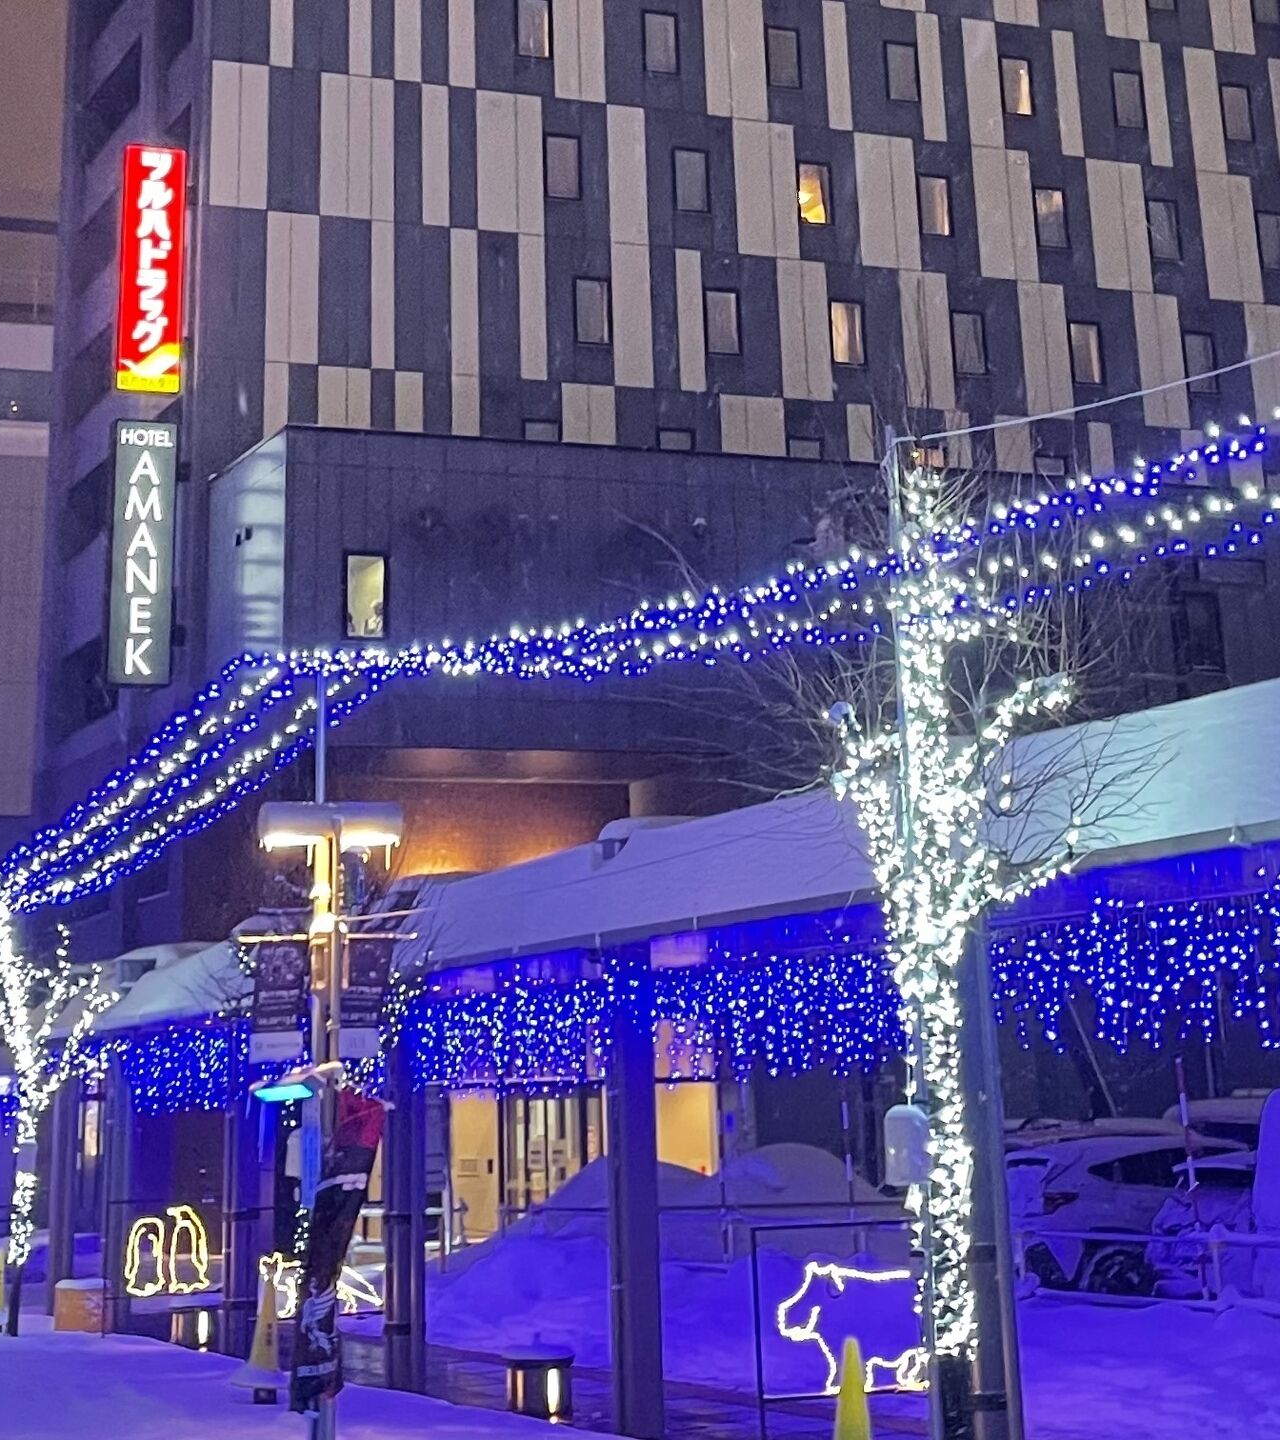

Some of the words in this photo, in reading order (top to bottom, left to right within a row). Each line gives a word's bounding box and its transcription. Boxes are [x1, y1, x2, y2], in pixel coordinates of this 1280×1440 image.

[131, 151, 174, 353] ツルハドラッグ
[120, 428, 174, 448] HOTEL
[124, 449, 163, 676] AMANEK
